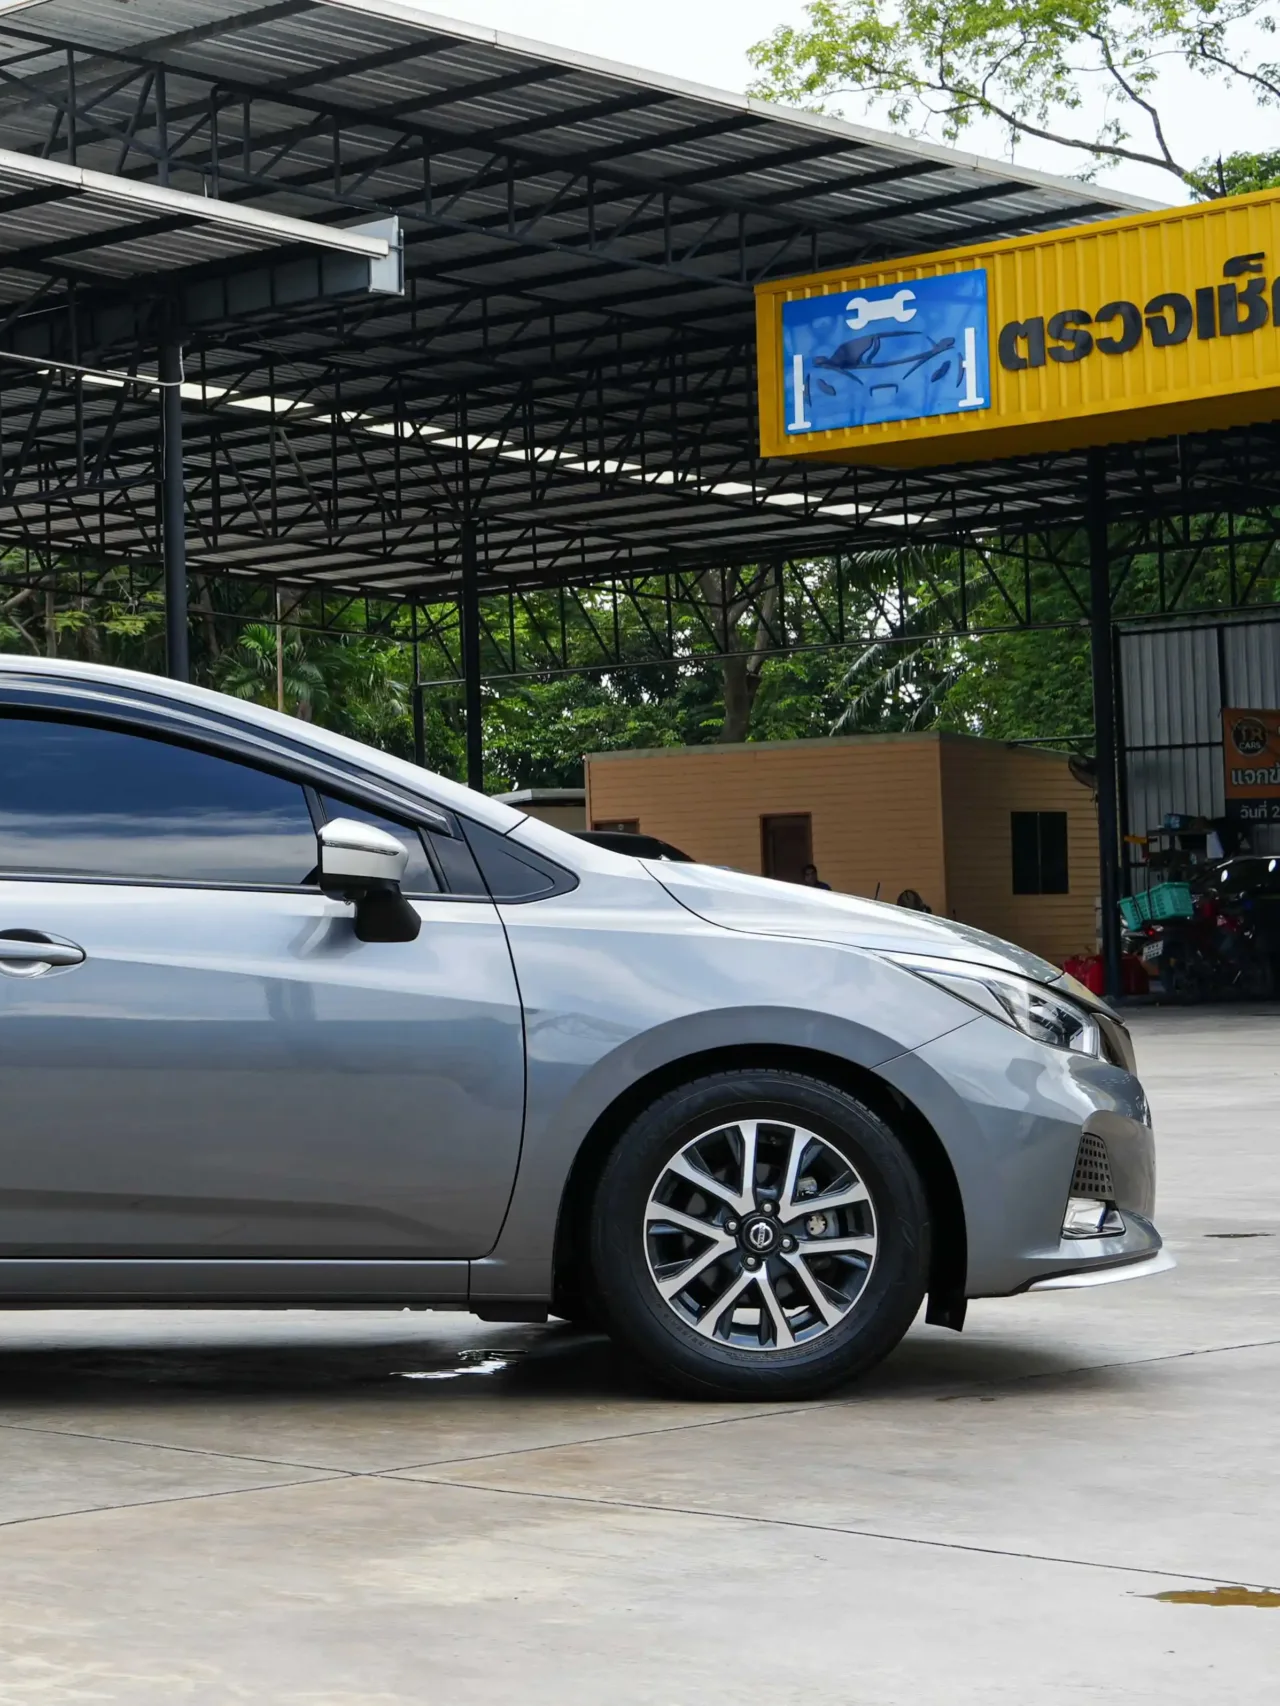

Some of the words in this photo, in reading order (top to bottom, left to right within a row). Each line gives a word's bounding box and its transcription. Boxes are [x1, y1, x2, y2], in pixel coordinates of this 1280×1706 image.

[998, 252, 1280, 372] ตรวจเช็
[1239, 741, 1261, 749] CARS
[1240, 800, 1268, 819] วันที่
